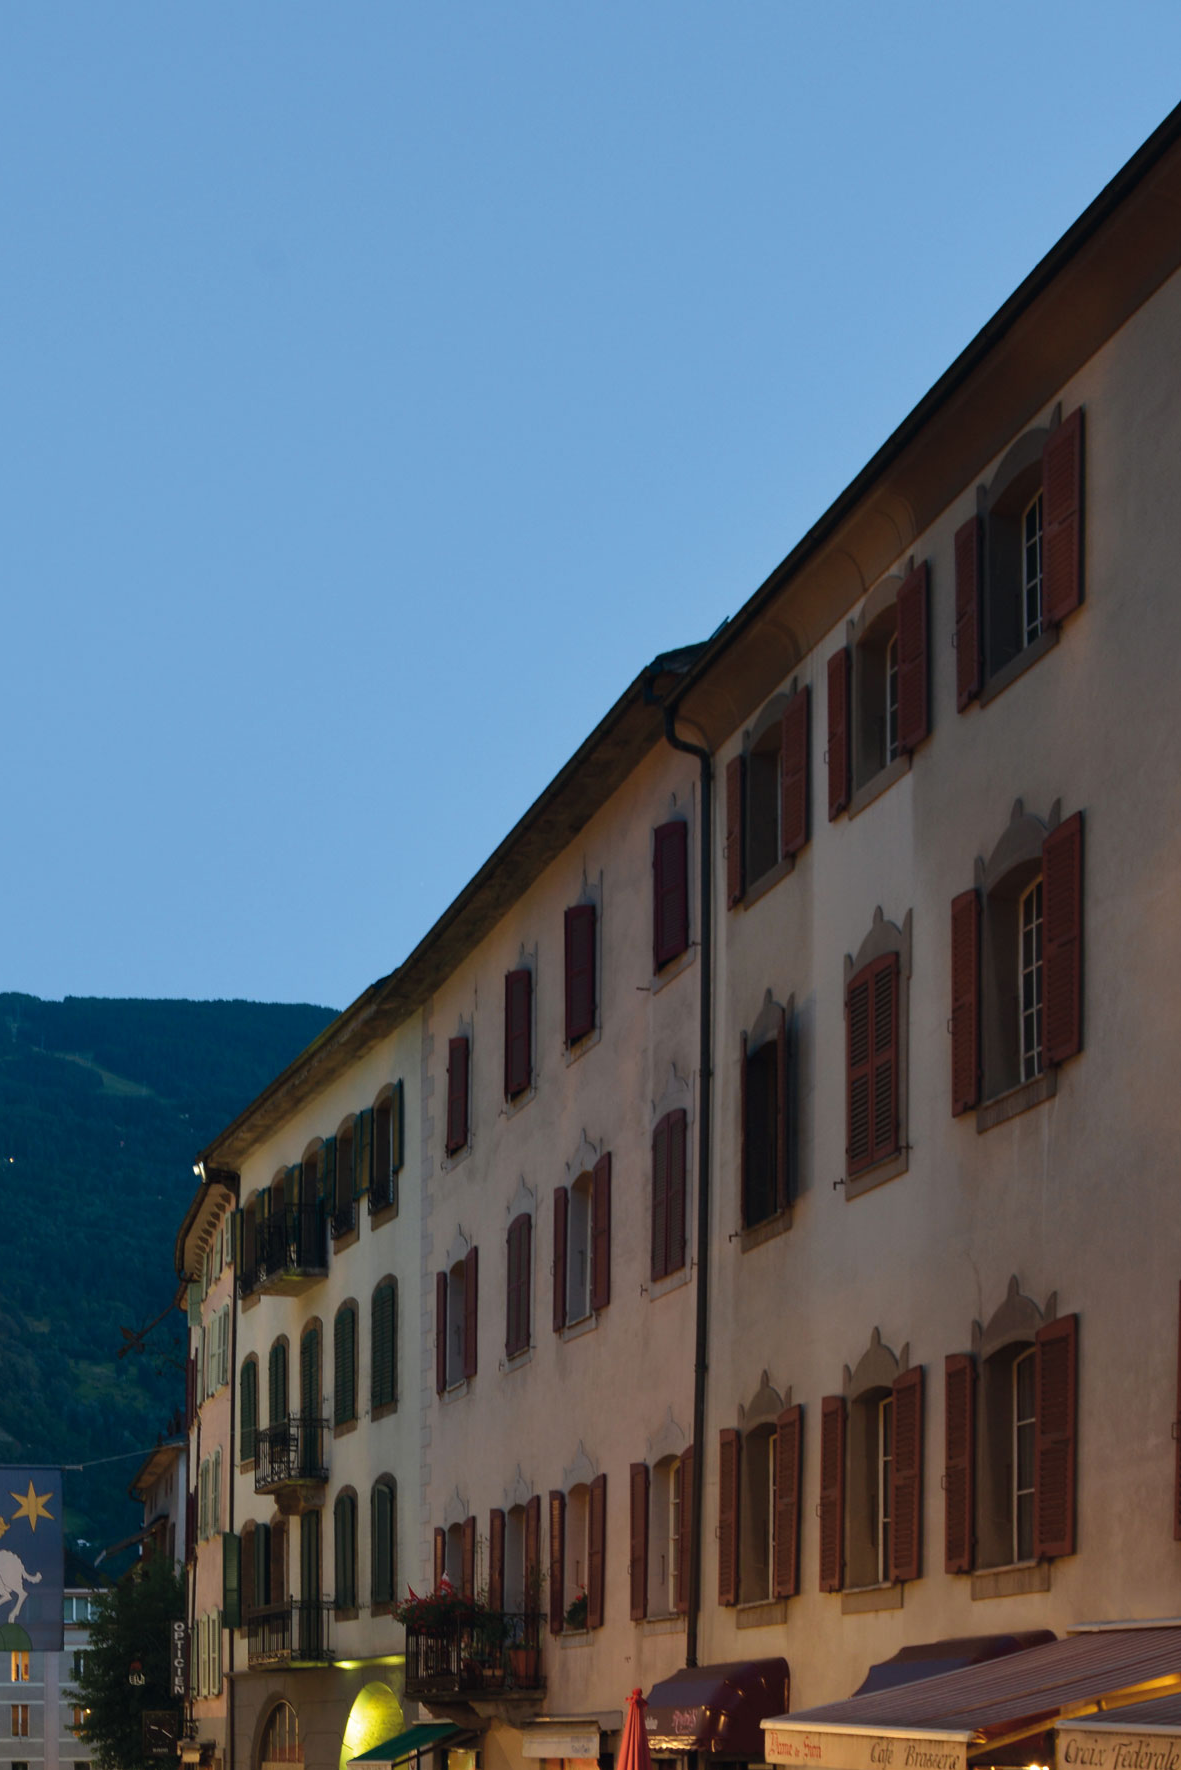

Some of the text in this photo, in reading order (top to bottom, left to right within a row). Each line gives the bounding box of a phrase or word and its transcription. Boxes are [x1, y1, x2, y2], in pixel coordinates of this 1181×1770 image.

[173, 1621, 185, 1695] OPTICIEN
[870, 1741, 960, 1770] Café Brasserie
[1064, 1738, 1106, 1767] Croix
